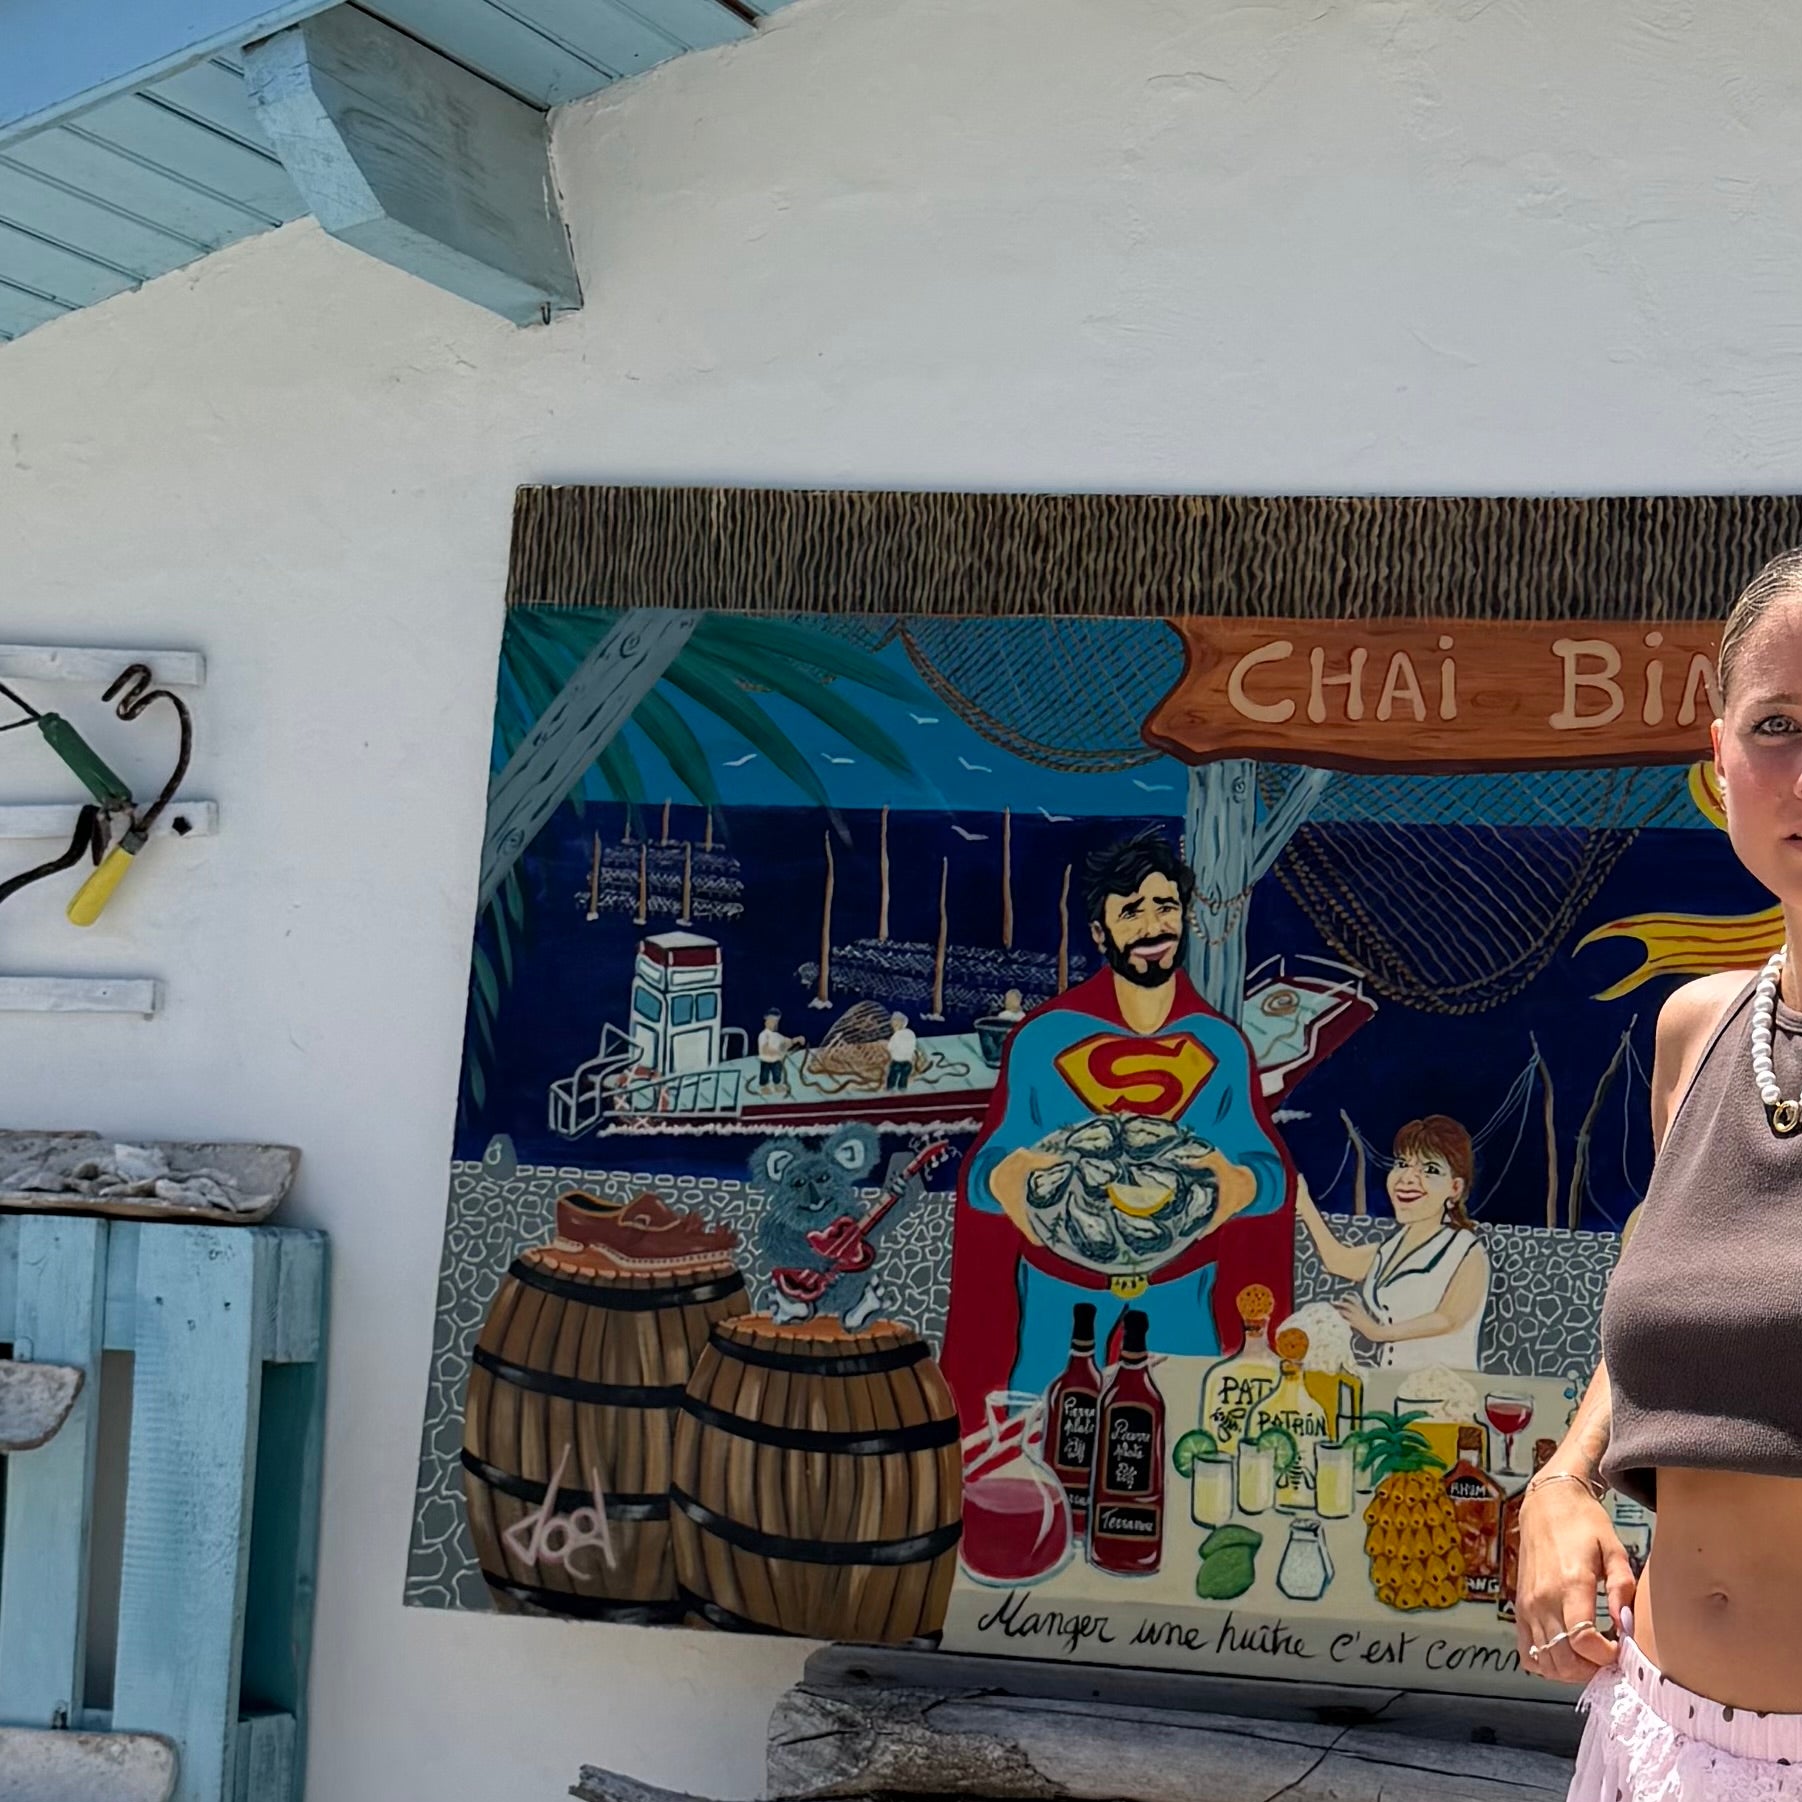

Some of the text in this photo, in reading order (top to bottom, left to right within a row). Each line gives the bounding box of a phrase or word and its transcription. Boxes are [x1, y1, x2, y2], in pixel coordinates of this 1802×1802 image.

[1227, 632, 1722, 729] CHAi BiN
[1088, 1038, 1187, 1116] S
[1218, 1376, 1275, 1405] PAT
[1466, 1578, 1499, 1593] ANG
[978, 1589, 1115, 1654] Manger
[1129, 1618, 1209, 1649] une
[1215, 1610, 1316, 1658] huître
[1330, 1631, 1418, 1664] c'est
